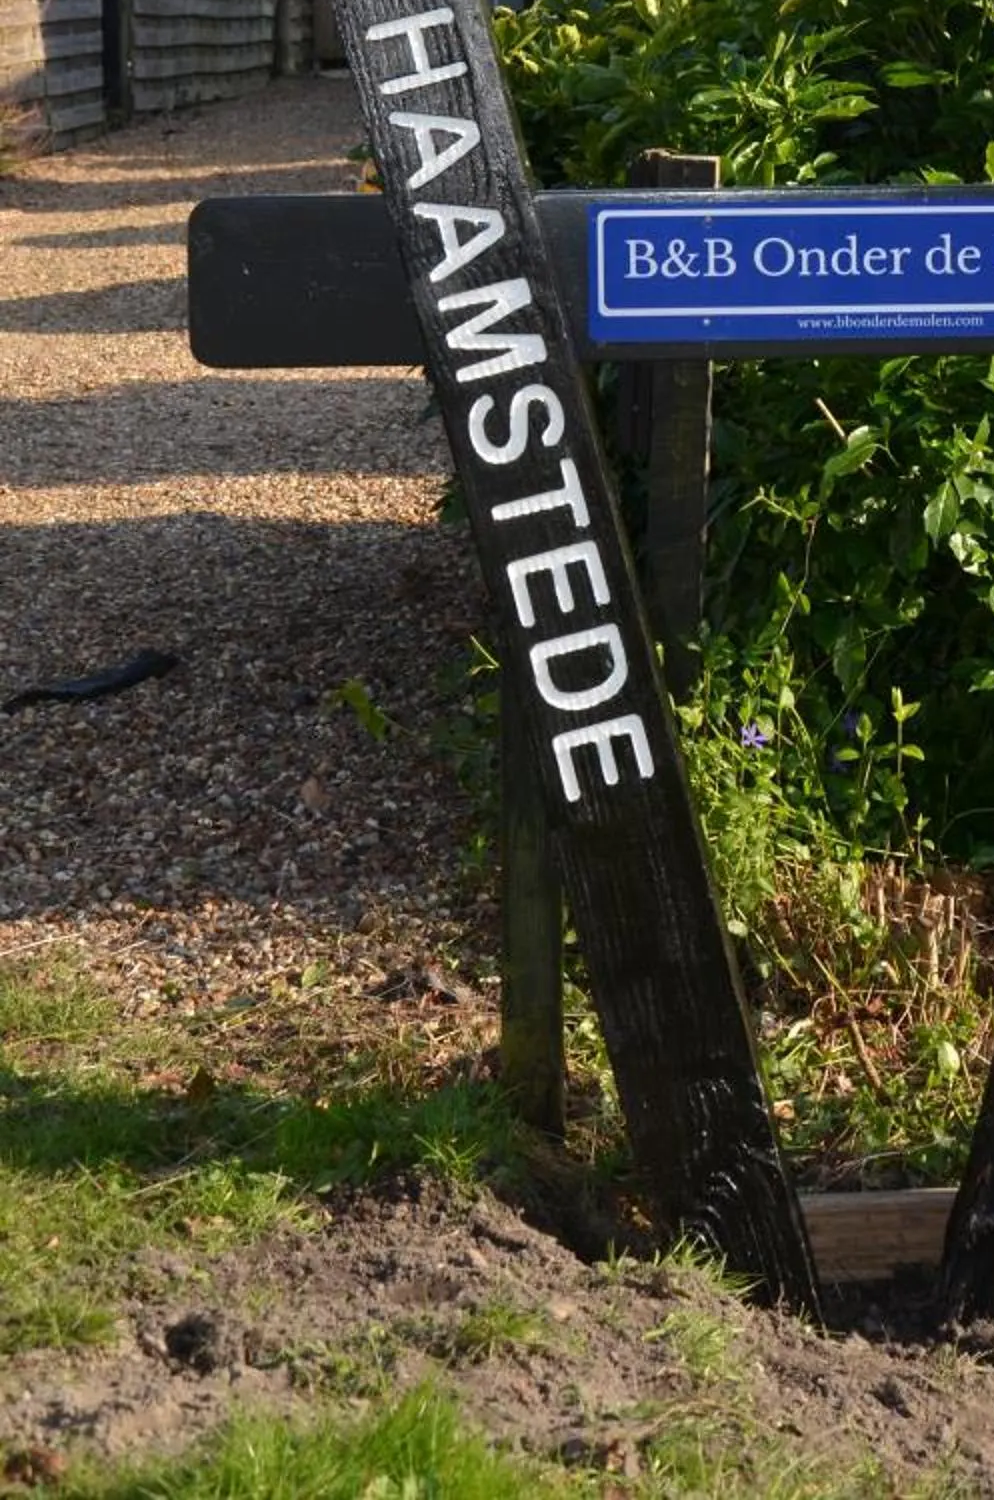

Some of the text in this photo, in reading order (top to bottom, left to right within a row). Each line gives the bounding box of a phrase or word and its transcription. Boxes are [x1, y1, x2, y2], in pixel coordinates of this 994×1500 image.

[624, 237, 737, 279] B&B
[752, 233, 912, 278] Onder
[924, 232, 981, 275] de
[797, 313, 984, 329] www.bbonderdemolen.com
[363, 5, 656, 804] HAAMSTEDE
